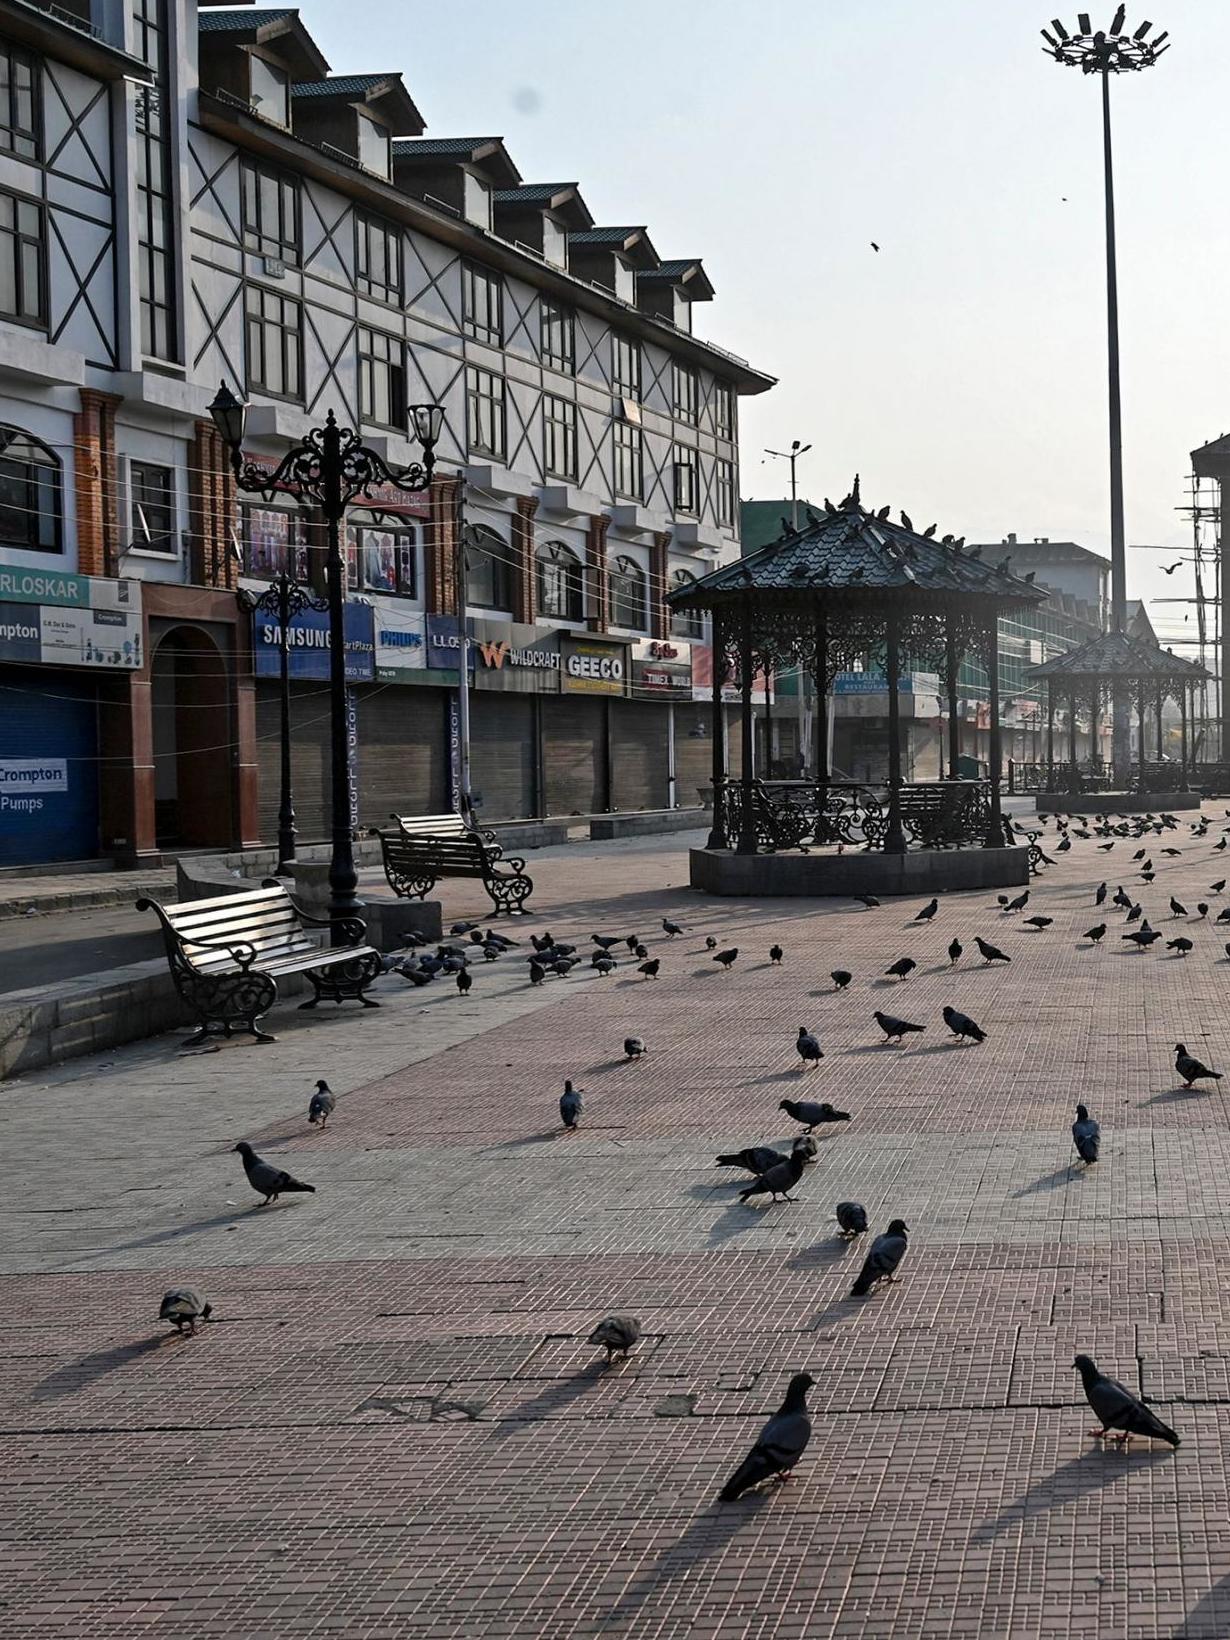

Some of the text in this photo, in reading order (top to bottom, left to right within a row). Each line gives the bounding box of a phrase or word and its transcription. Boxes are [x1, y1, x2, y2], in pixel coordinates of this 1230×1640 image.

[0, 574, 78, 599] RLOSKAR
[511, 647, 560, 669] WILDCRAFT
[568, 654, 623, 680] GEECO
[835, 672, 855, 681] OTEL
[1, 796, 44, 813] Pumps
